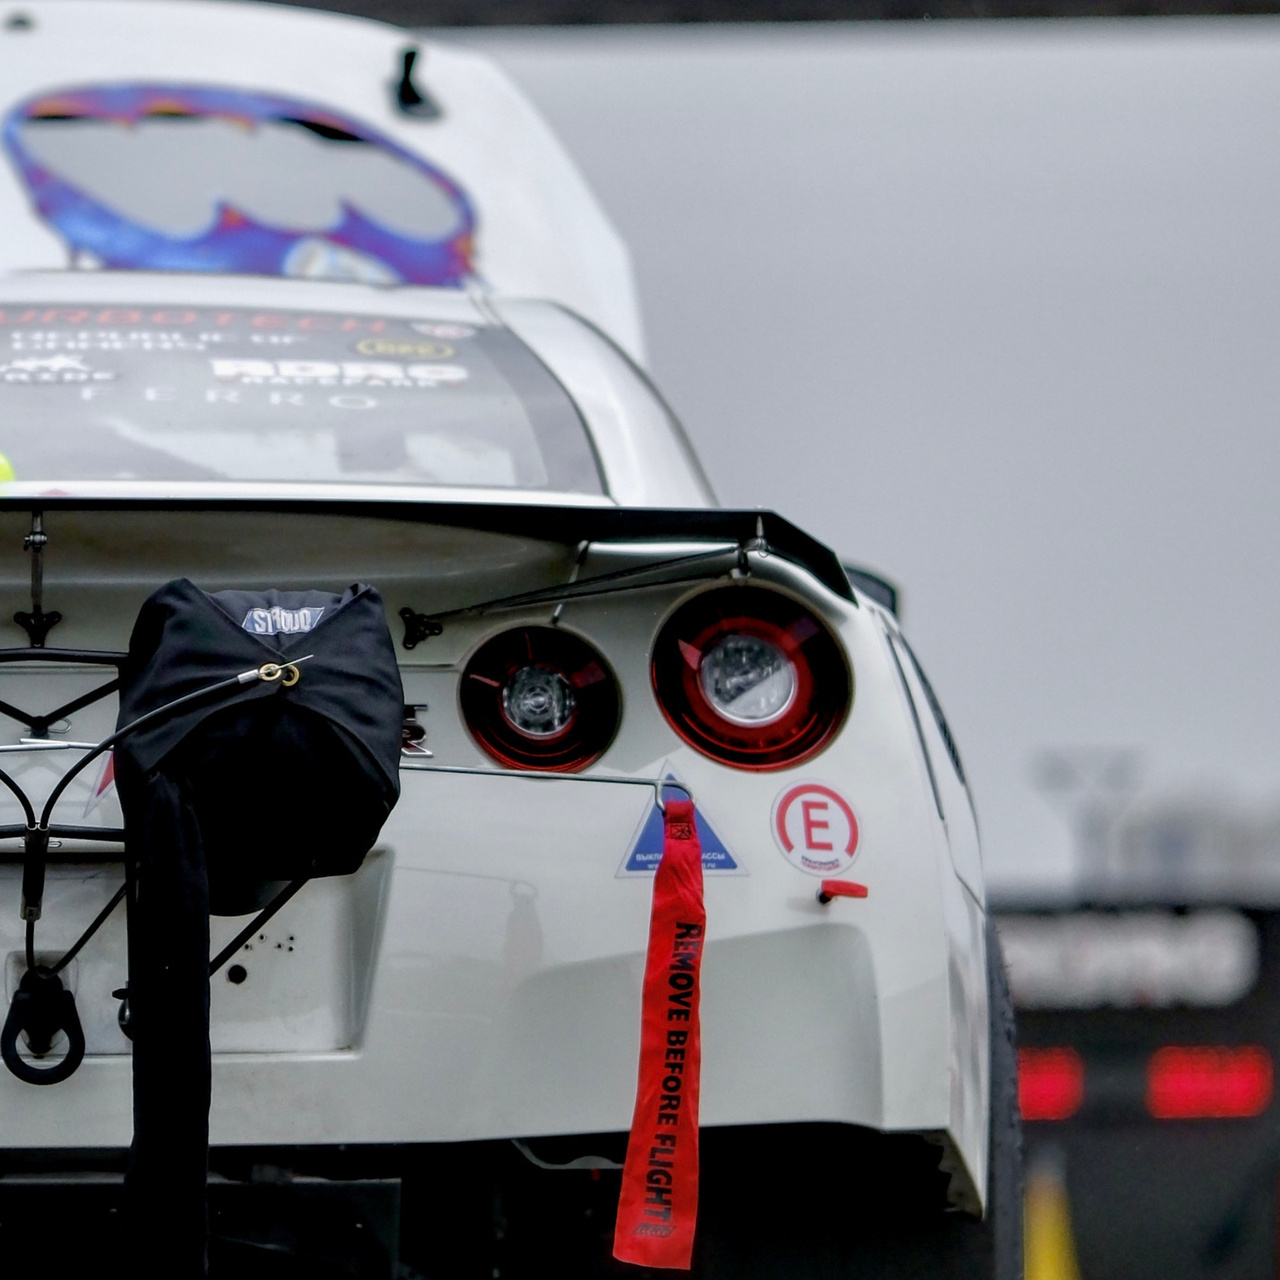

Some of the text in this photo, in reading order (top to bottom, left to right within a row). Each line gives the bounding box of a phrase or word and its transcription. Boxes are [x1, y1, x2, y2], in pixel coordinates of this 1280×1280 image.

[802, 800, 833, 851] E
[667, 922, 701, 1022] REMOVE
[659, 1031, 688, 1127] BEFORE
[646, 1132, 676, 1223] FLIGHT
